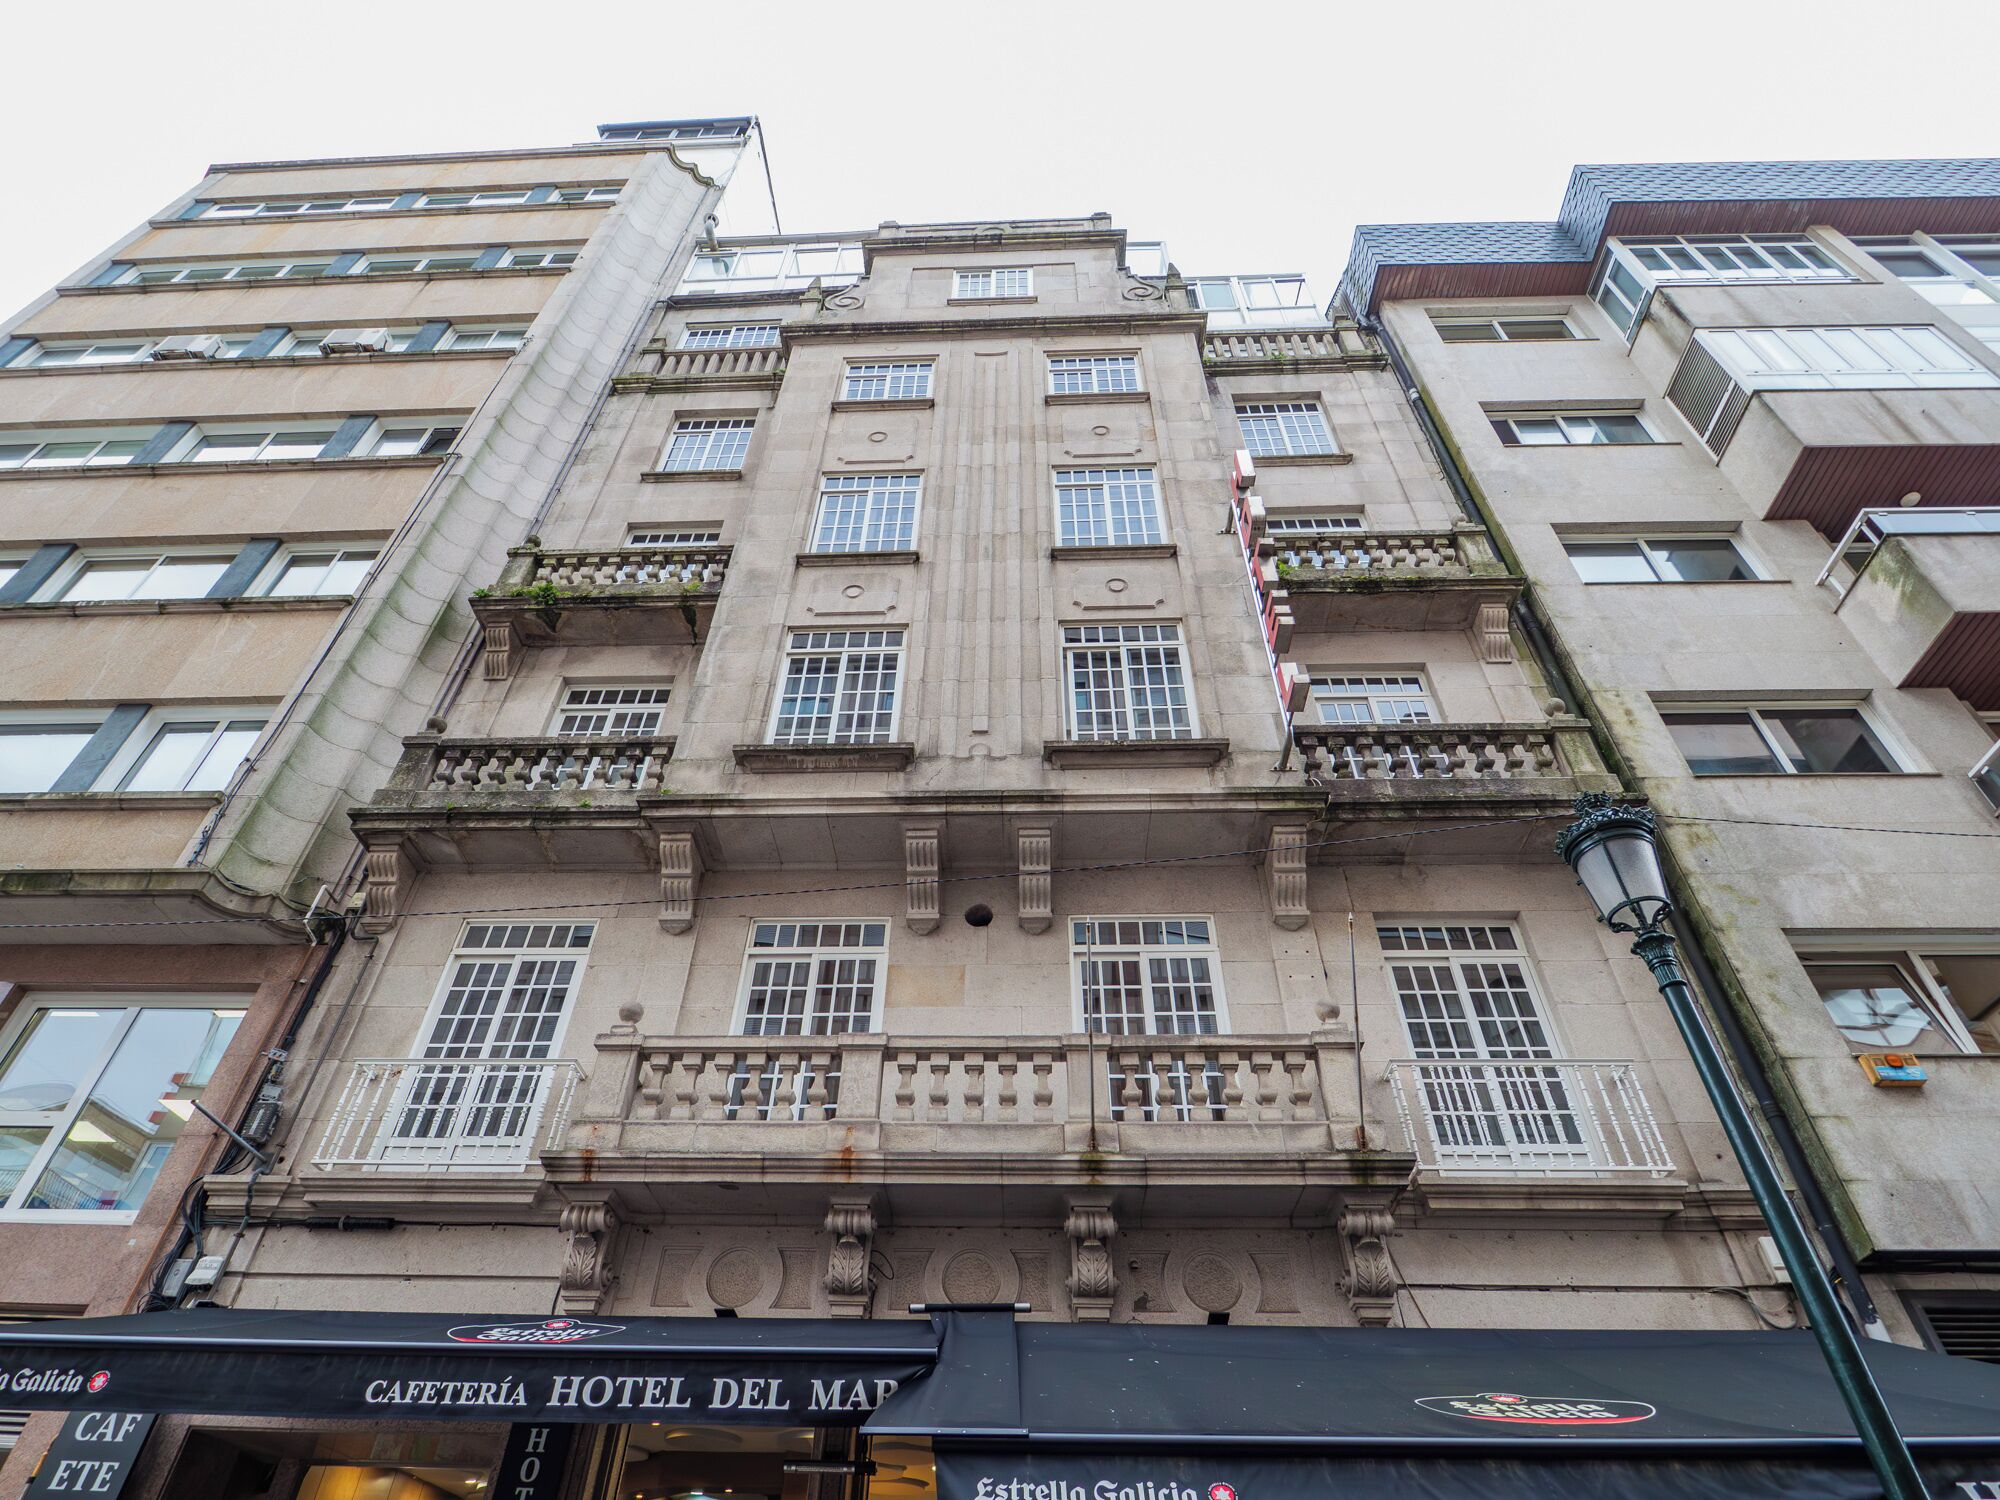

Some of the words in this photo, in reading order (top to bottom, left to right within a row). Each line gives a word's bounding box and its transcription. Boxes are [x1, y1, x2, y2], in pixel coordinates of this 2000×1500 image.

[484, 1328, 600, 1336] Estrella
[11, 1368, 84, 1392] Galicia
[365, 1376, 527, 1406] CAFETERÍA
[546, 1376, 691, 1408] HOTEL
[708, 1378, 790, 1409] DEL
[807, 1379, 899, 1410] MAR
[1449, 1401, 1606, 1412] Estrella
[1468, 1407, 1619, 1418] Galicia
[74, 1412, 143, 1442] CAF
[47, 1460, 120, 1492] ETE
[974, 1477, 1086, 1500] Estrella
[1093, 1480, 1198, 1500] Galicia
